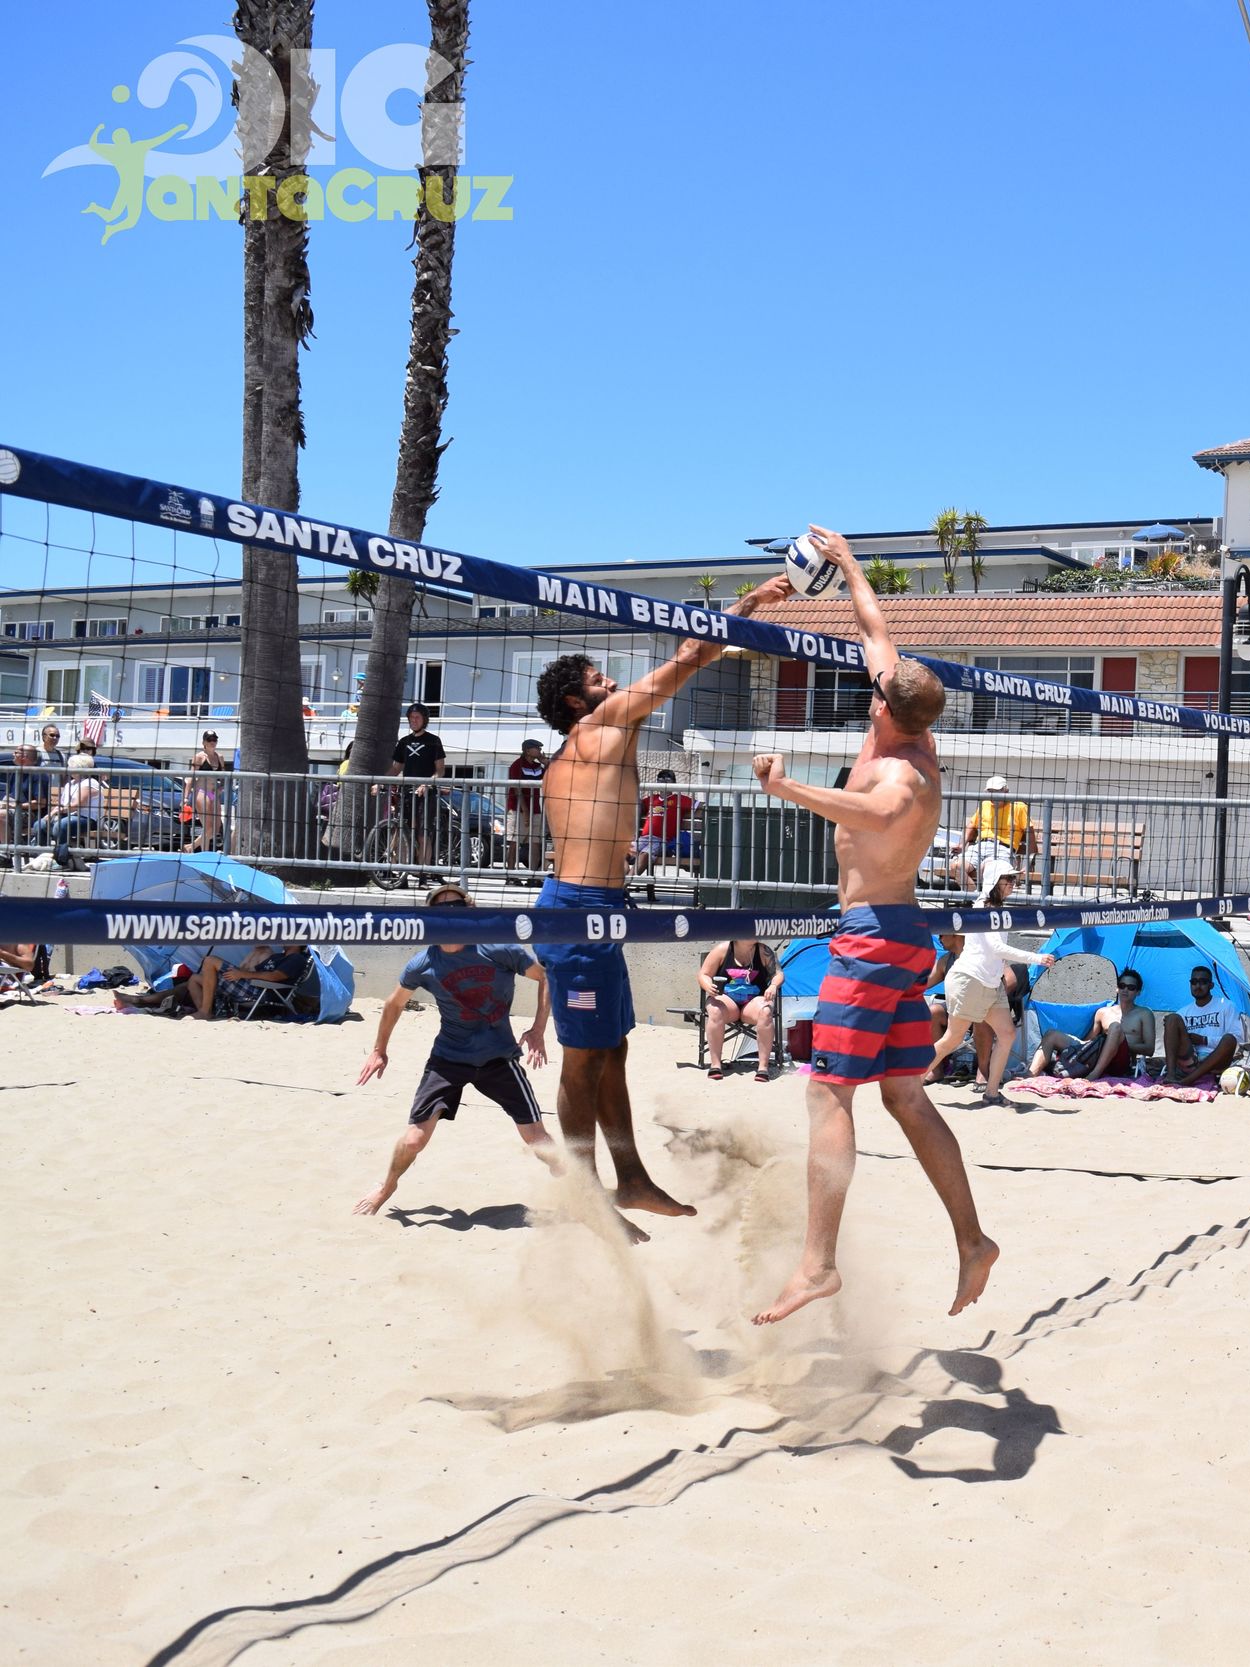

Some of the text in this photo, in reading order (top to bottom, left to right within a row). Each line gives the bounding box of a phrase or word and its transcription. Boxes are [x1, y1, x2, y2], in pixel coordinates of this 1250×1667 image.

[226, 503, 464, 584] SANTA CRUZ
[812, 564, 836, 591] Wilson
[537, 575, 729, 639] MAIN BEACH
[983, 671, 1072, 705] SANTA CRUZ
[1099, 694, 1180, 723] MAIN BEACH
[106, 912, 425, 941] www.santacruzwharf.com
[1080, 905, 1169, 926] www.santacruzwharf.com
